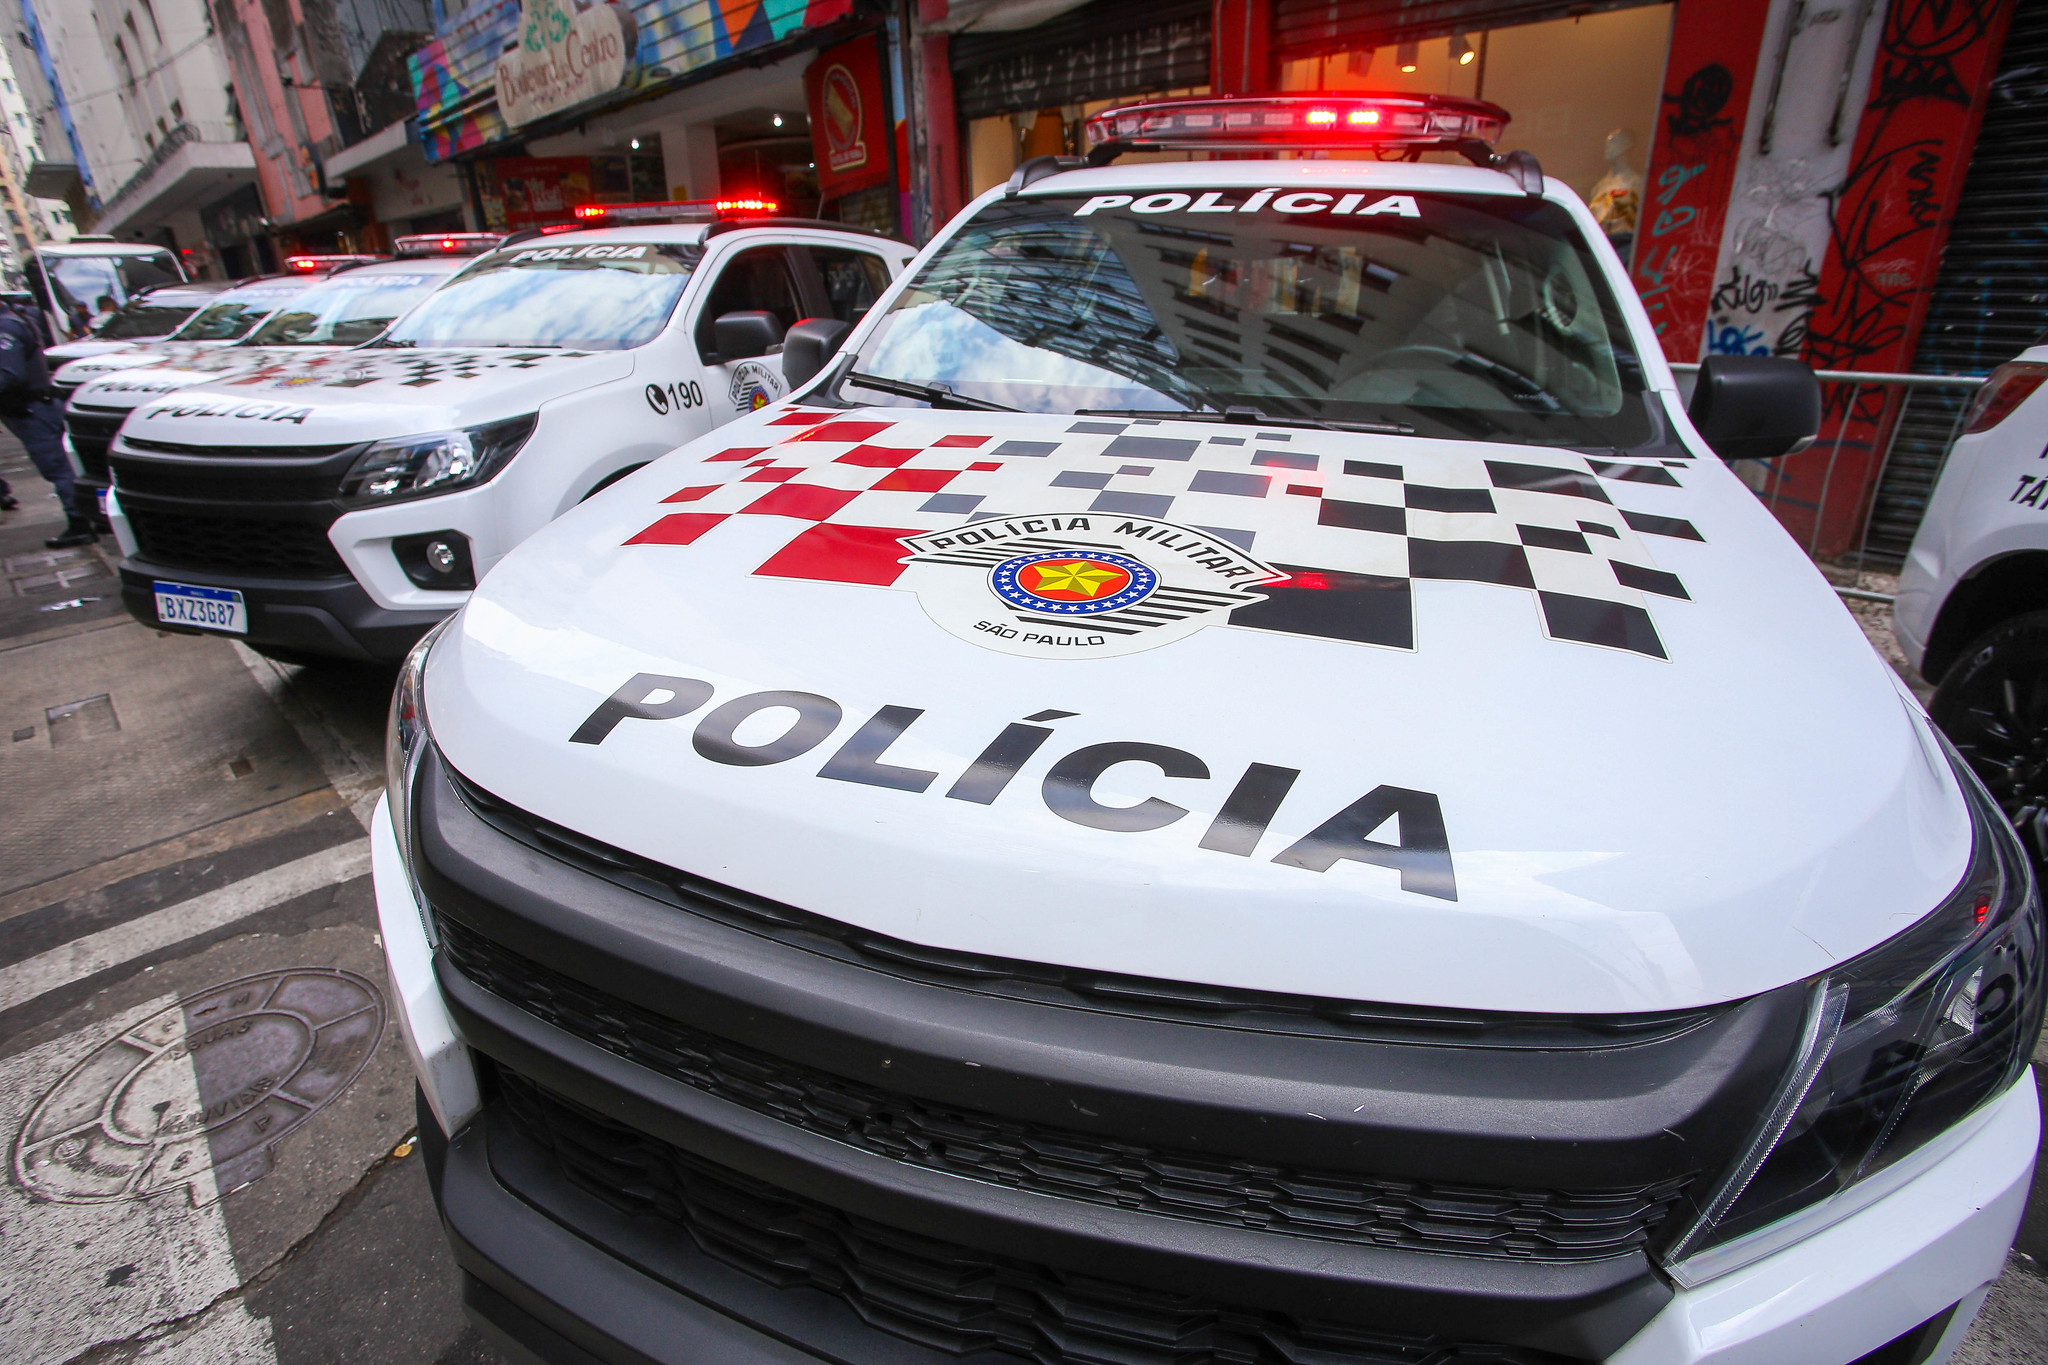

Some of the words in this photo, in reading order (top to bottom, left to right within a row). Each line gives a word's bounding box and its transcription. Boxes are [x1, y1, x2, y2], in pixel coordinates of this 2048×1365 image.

[566, 30, 618, 78] Centro
[1073, 188, 1421, 217] POLÍCIA
[509, 244, 647, 264] POLÍCIA
[751, 365, 778, 391] MILITAR
[668, 380, 703, 410] 190
[2008, 474, 2048, 510] TÁ
[929, 517, 1091, 549] POLÍCIA
[1113, 521, 1255, 578] MILITAR
[165, 596, 235, 627] BXZ3G87
[973, 620, 1019, 639] SÃO
[1022, 633, 1105, 646] PAULO
[568, 672, 1458, 902] POLÍCIA
